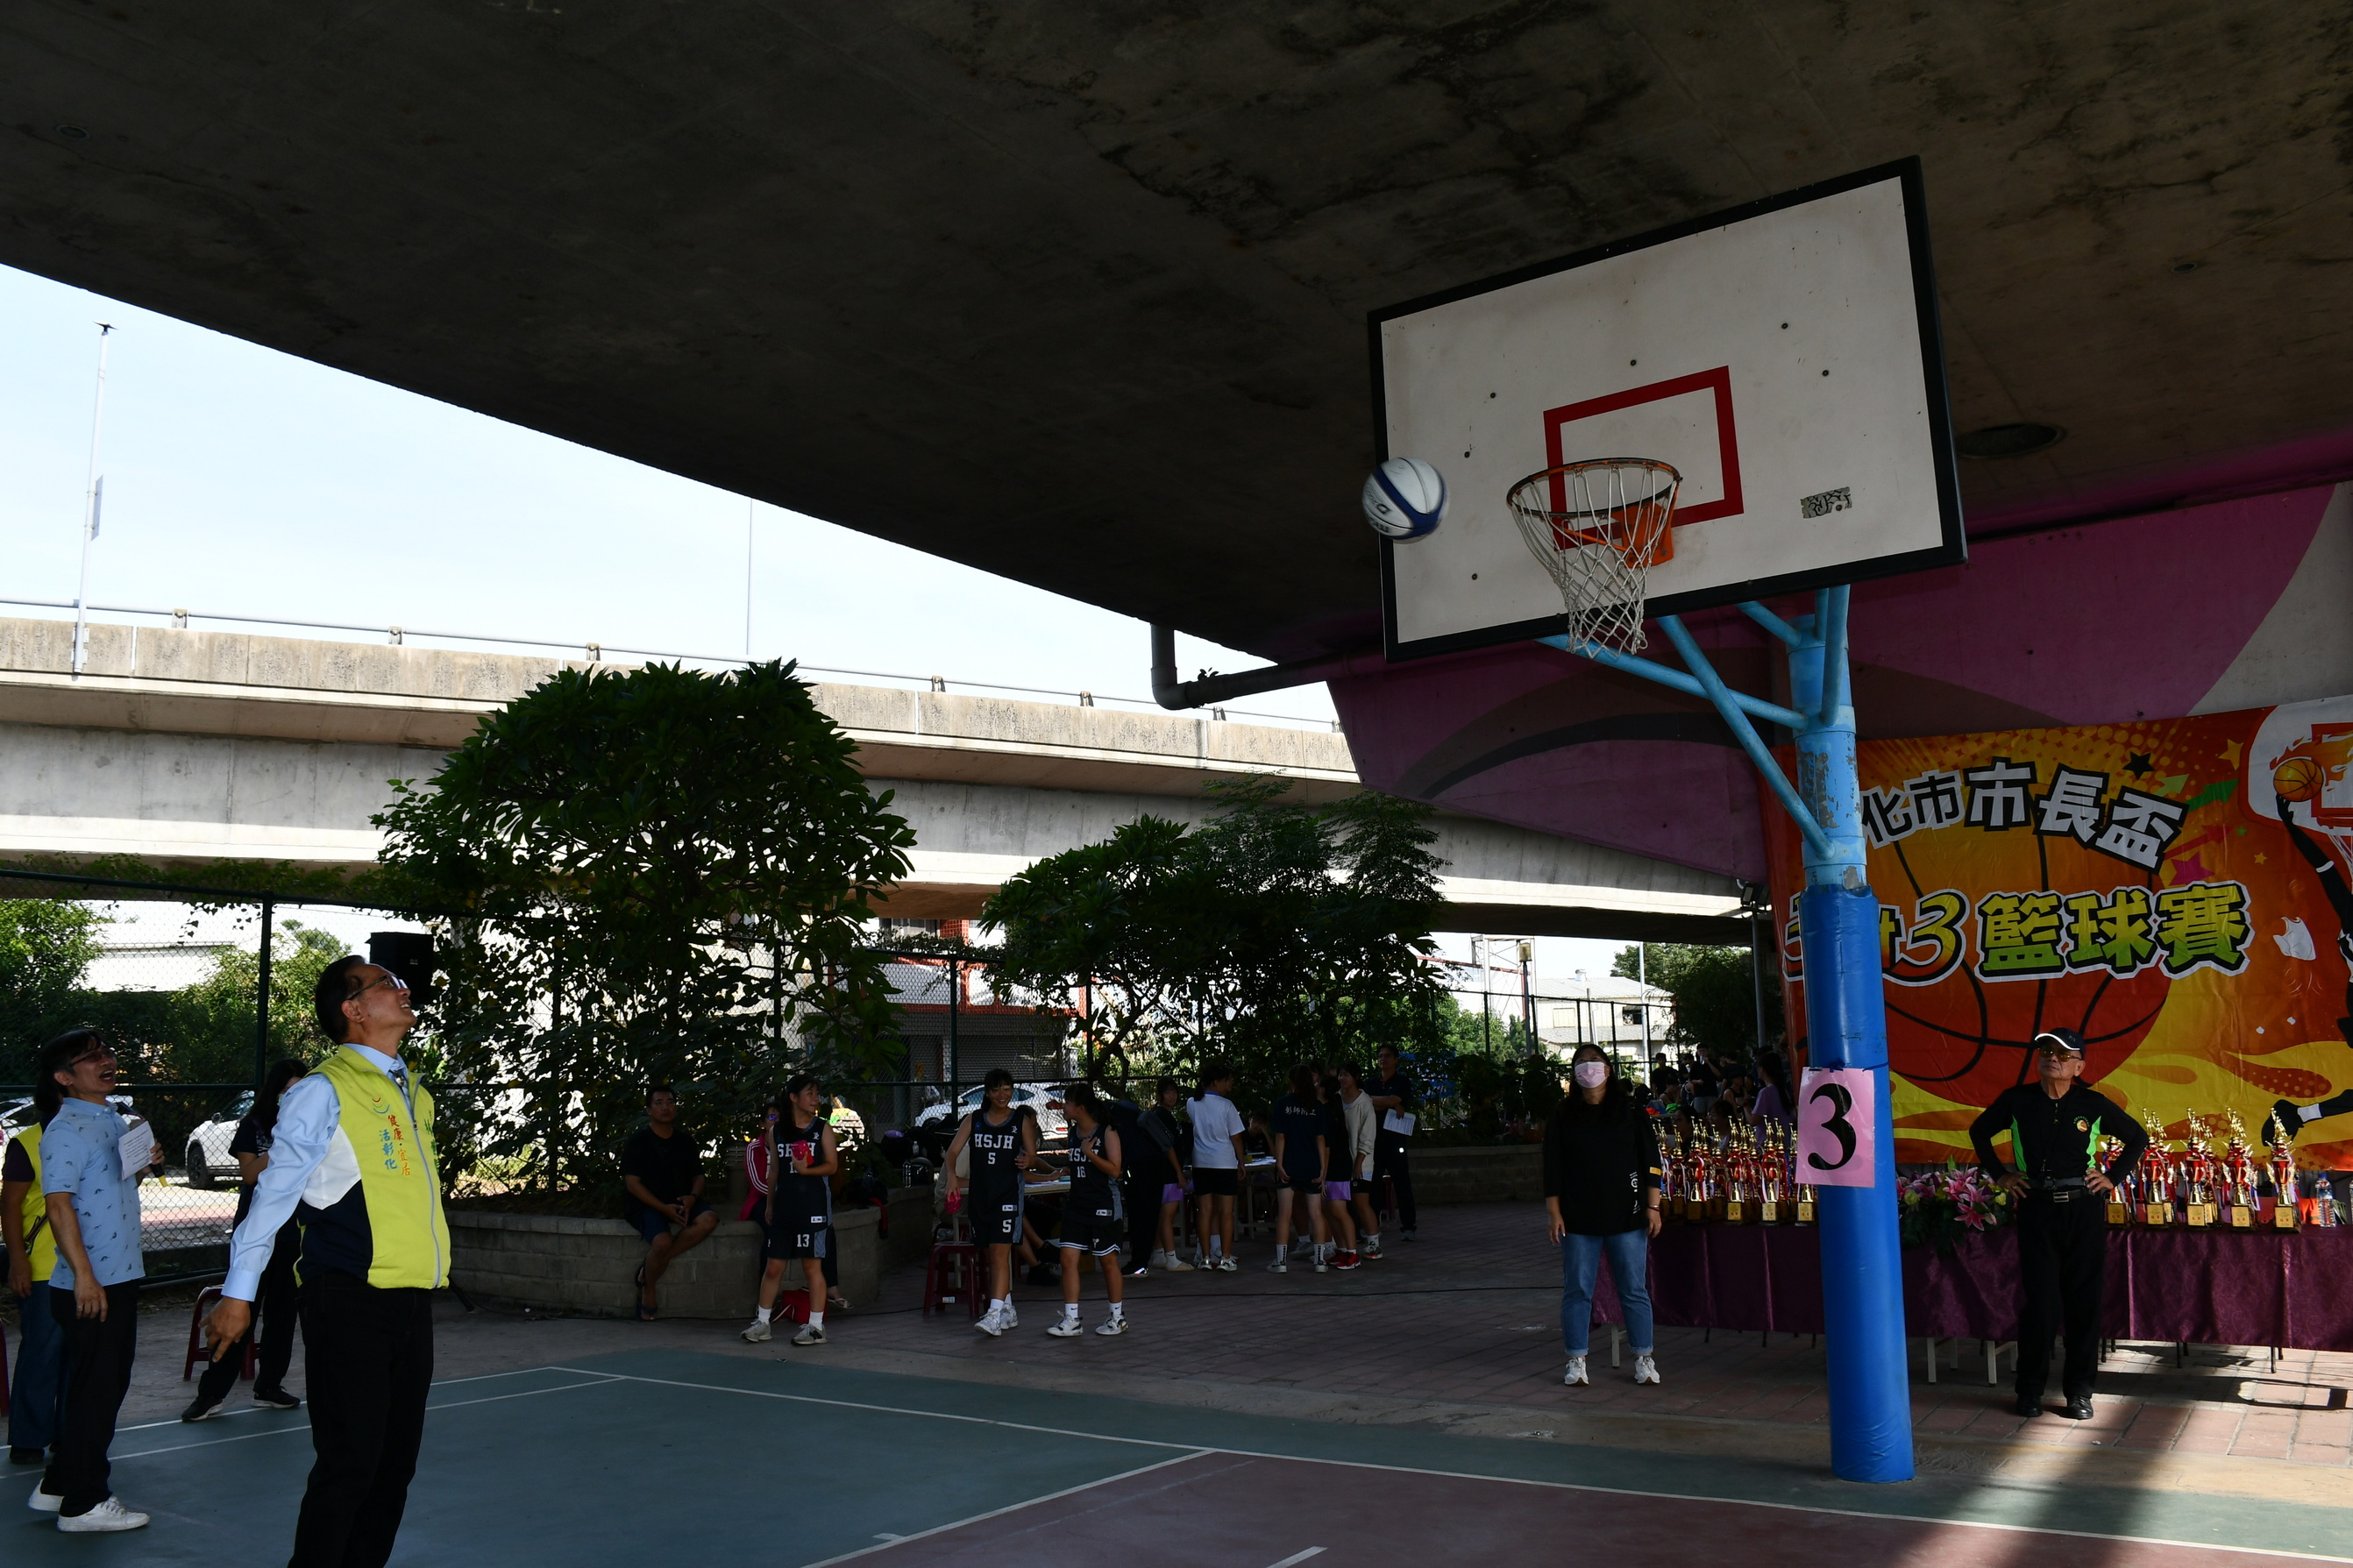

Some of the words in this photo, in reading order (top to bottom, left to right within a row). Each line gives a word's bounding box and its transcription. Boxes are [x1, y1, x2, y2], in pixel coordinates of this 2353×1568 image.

[1807, 1082, 1857, 1170] 3
[974, 1133, 1014, 1150] HSJH
[987, 1152, 996, 1165] 5
[1077, 1166, 1087, 1179] 16
[1002, 1218, 1013, 1233] 5
[796, 1233, 810, 1248] 13
